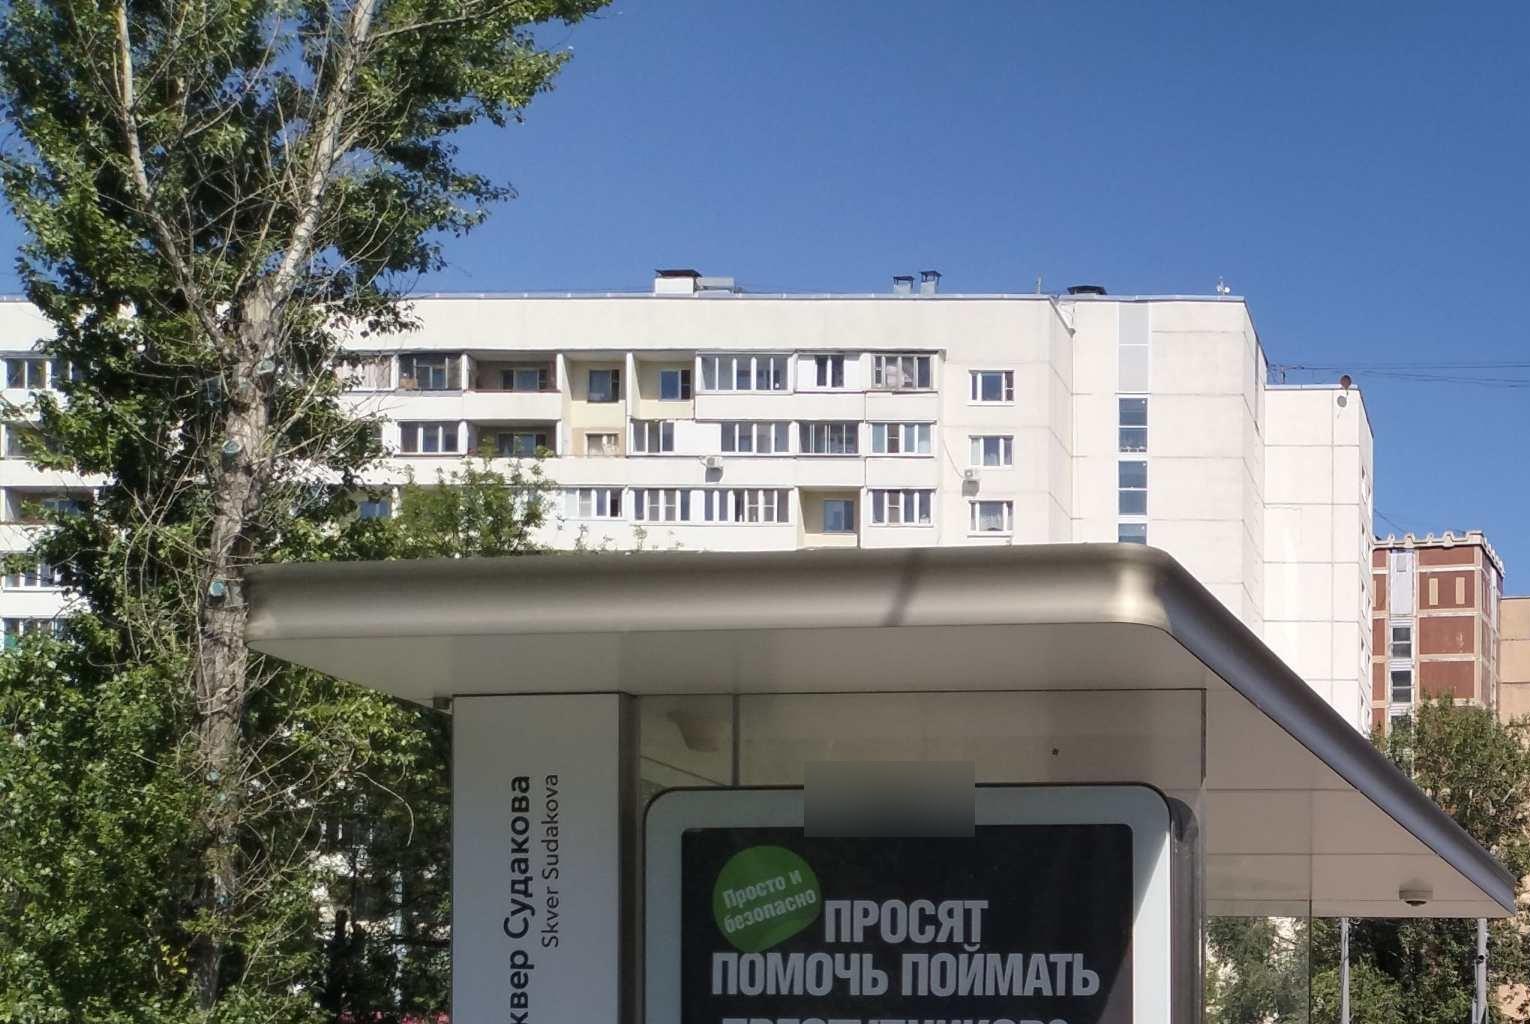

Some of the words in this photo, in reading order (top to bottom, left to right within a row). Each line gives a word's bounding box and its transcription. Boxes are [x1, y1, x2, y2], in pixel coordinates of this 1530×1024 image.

[541, 774, 559, 881] Sudakova
[503, 775, 535, 939] Судакова
[541, 886, 559, 949] Skver
[722, 875, 786, 909] Просто
[723, 889, 817, 934] безопасно
[824, 899, 989, 943] ПРОСЯТ
[711, 951, 888, 997] ПОМОЧЬ
[901, 945, 1100, 997] ПОЙМАТЬ
